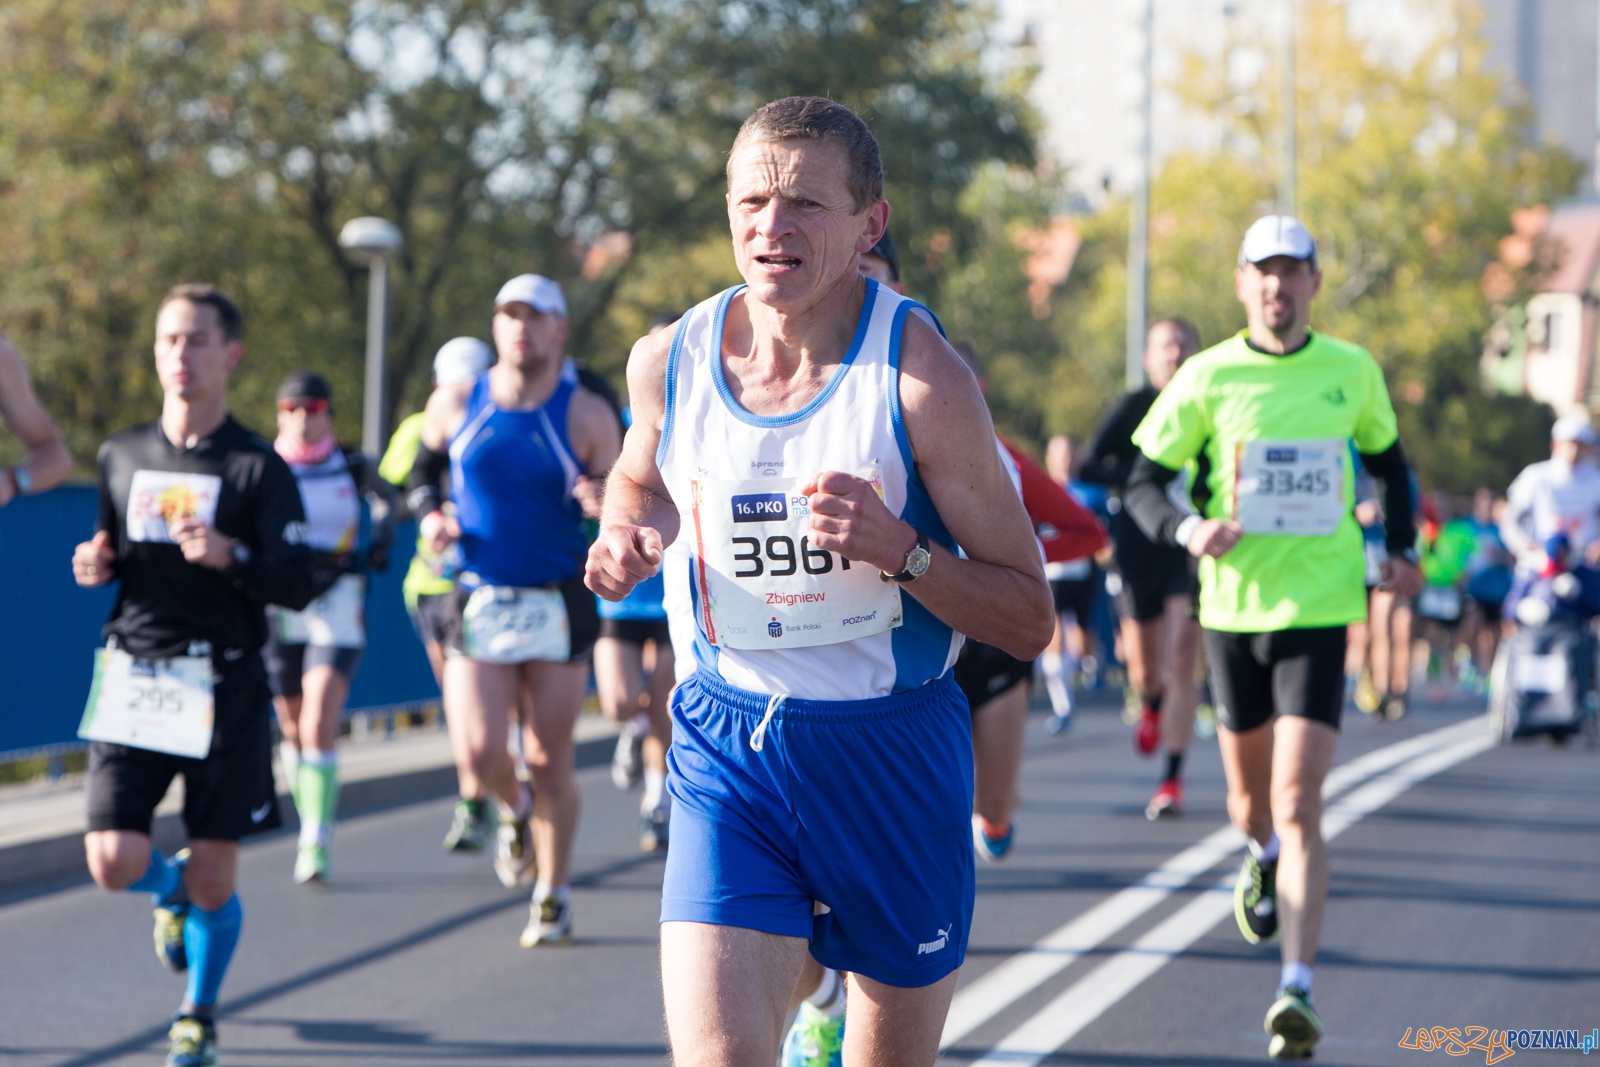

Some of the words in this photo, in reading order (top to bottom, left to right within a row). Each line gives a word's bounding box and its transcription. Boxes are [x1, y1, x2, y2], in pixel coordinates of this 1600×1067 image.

[1255, 468, 1331, 496] 3345
[735, 502, 755, 515] 16.
[755, 500, 783, 514] PKO
[731, 534, 851, 578] 396
[765, 592, 826, 606] Zbigniew
[803, 622, 822, 631] Polski
[128, 685, 184, 714] 295
